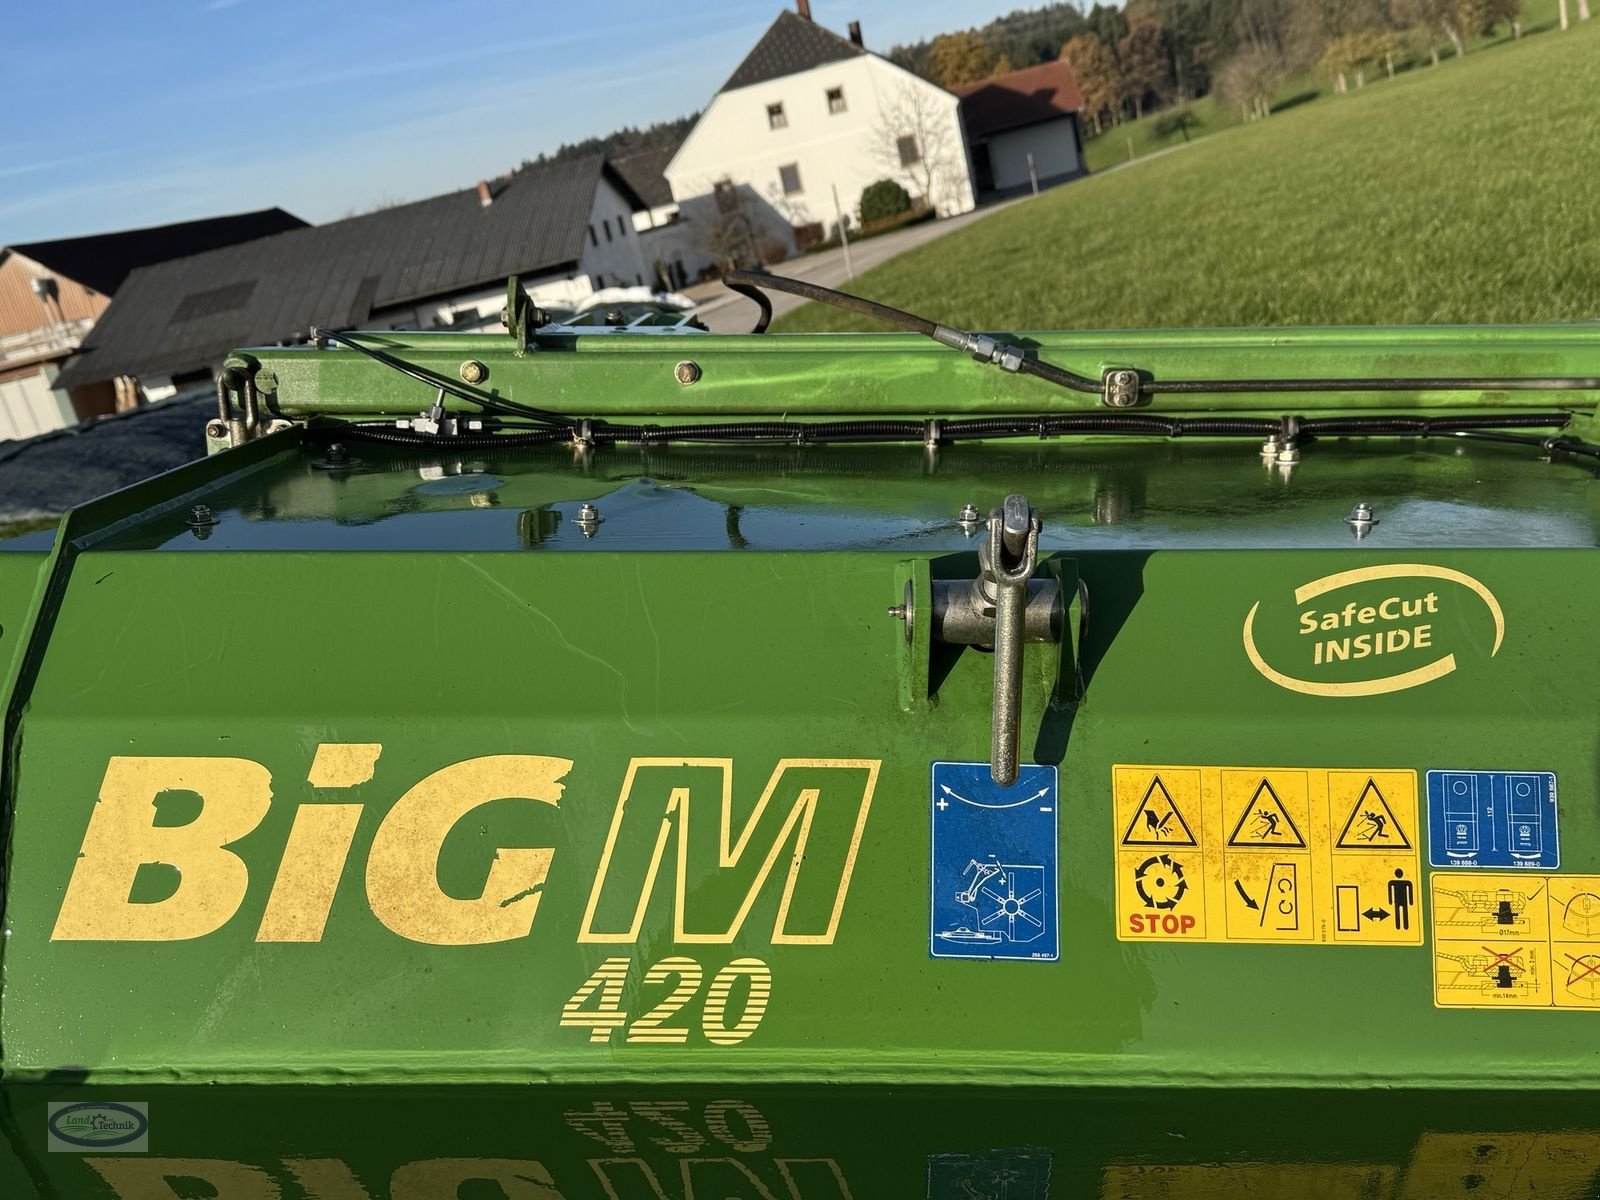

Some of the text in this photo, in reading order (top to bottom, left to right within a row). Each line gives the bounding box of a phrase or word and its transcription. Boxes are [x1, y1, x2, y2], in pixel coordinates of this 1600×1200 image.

[1299, 592, 1438, 634] SafeCut
[1314, 624, 1432, 665] INSIDE
[578, 757, 881, 946] M
[1129, 914, 1196, 934] STOP
[560, 957, 771, 1045] 420
